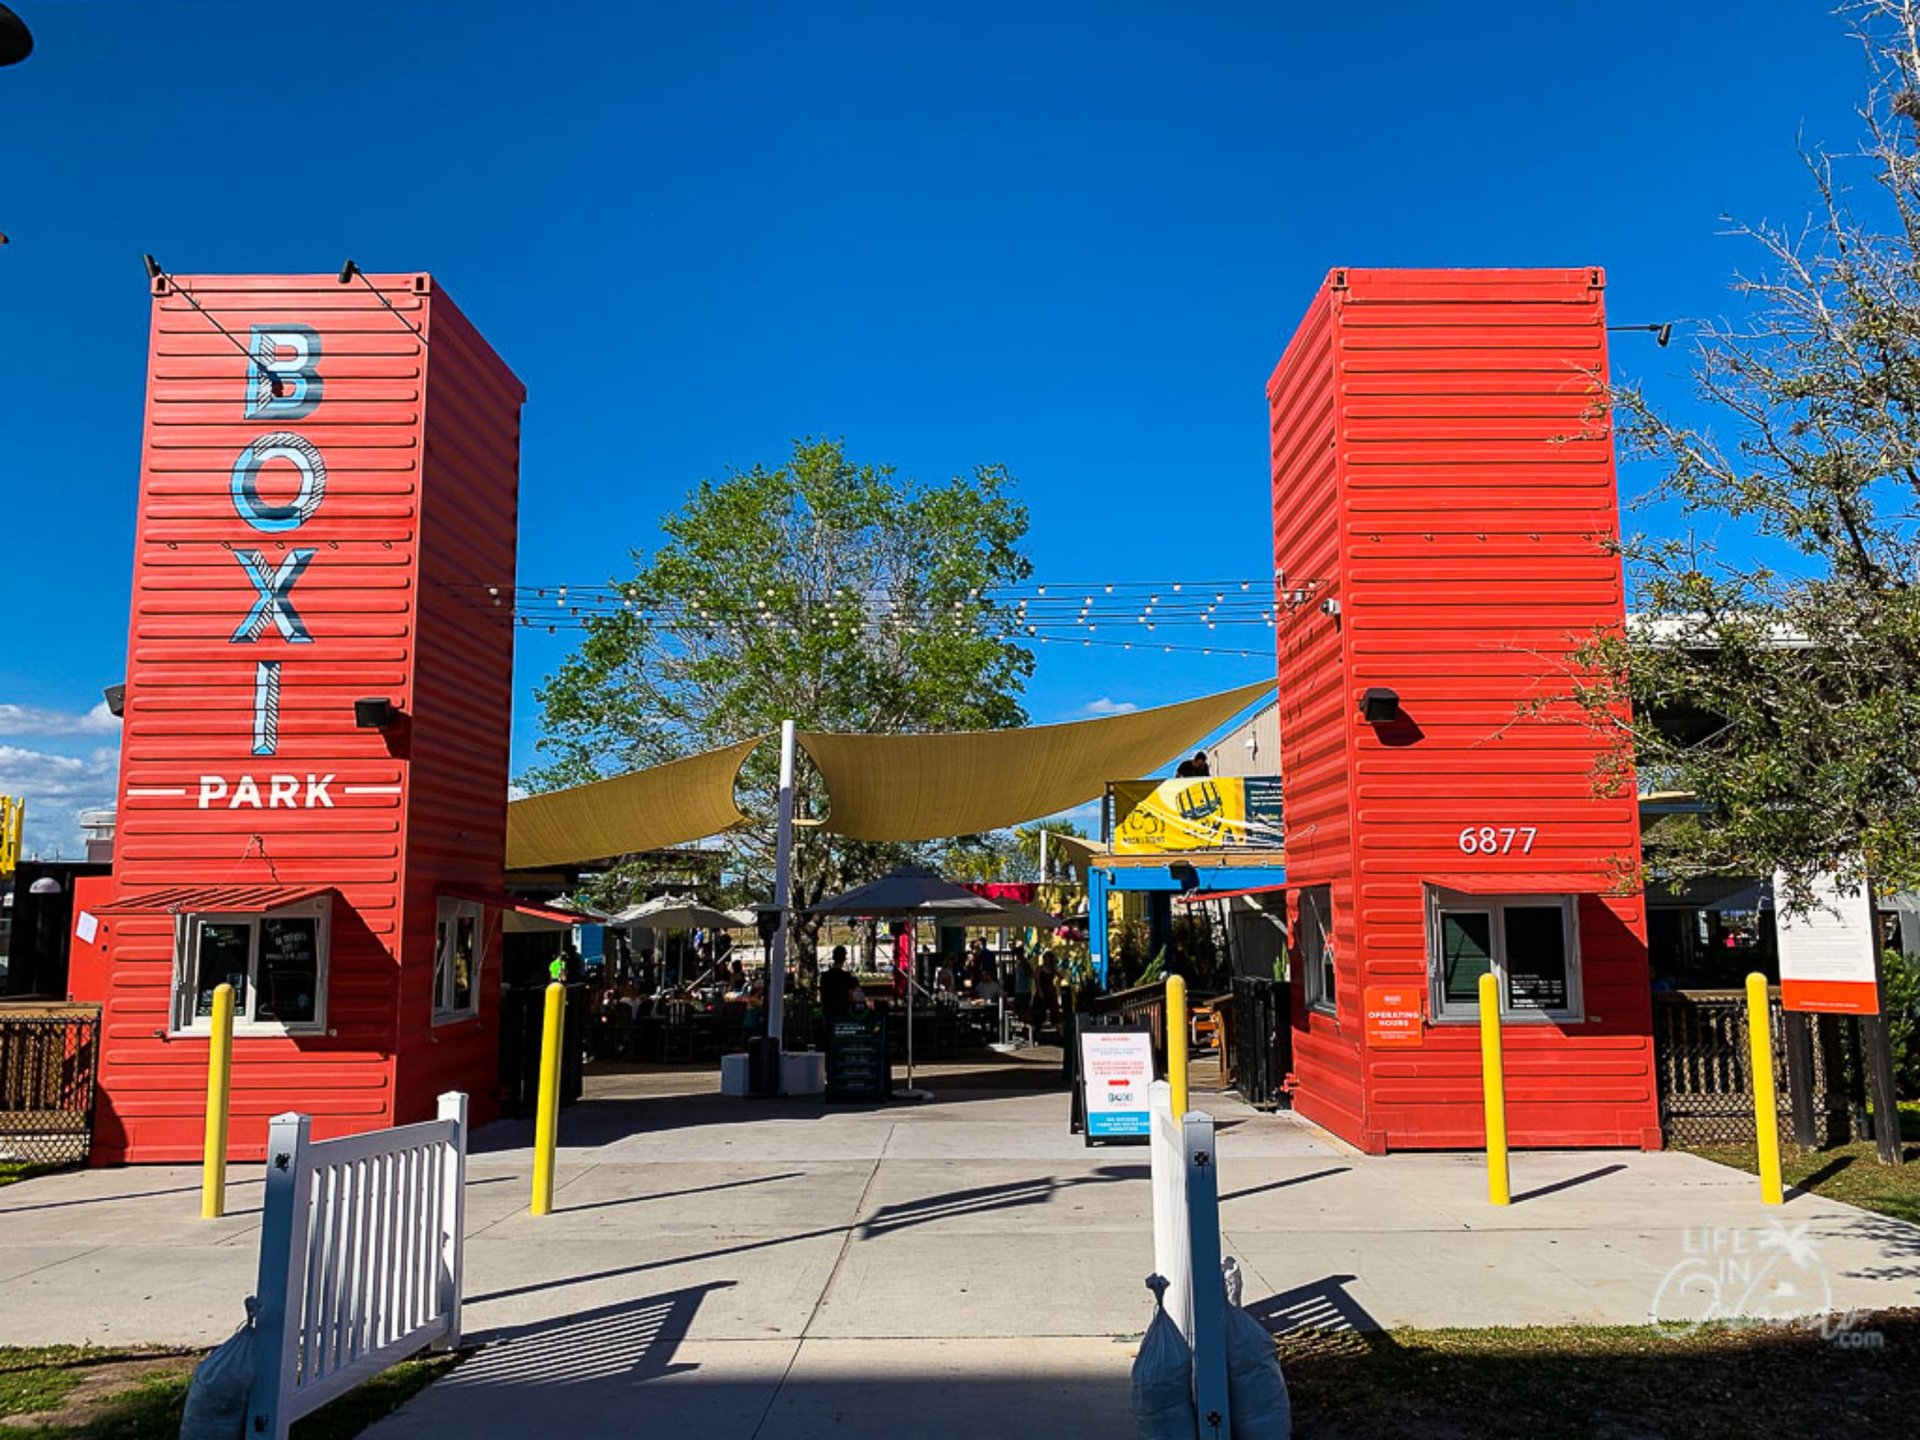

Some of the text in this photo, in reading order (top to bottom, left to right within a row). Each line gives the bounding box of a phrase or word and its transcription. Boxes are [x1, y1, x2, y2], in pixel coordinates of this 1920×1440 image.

[229, 323, 327, 756] BOXI
[198, 774, 336, 809] PARK
[1459, 827, 1538, 855] 6877
[1368, 1011, 1420, 1019] OPERATING
[1379, 1019, 1409, 1027] HOURS
